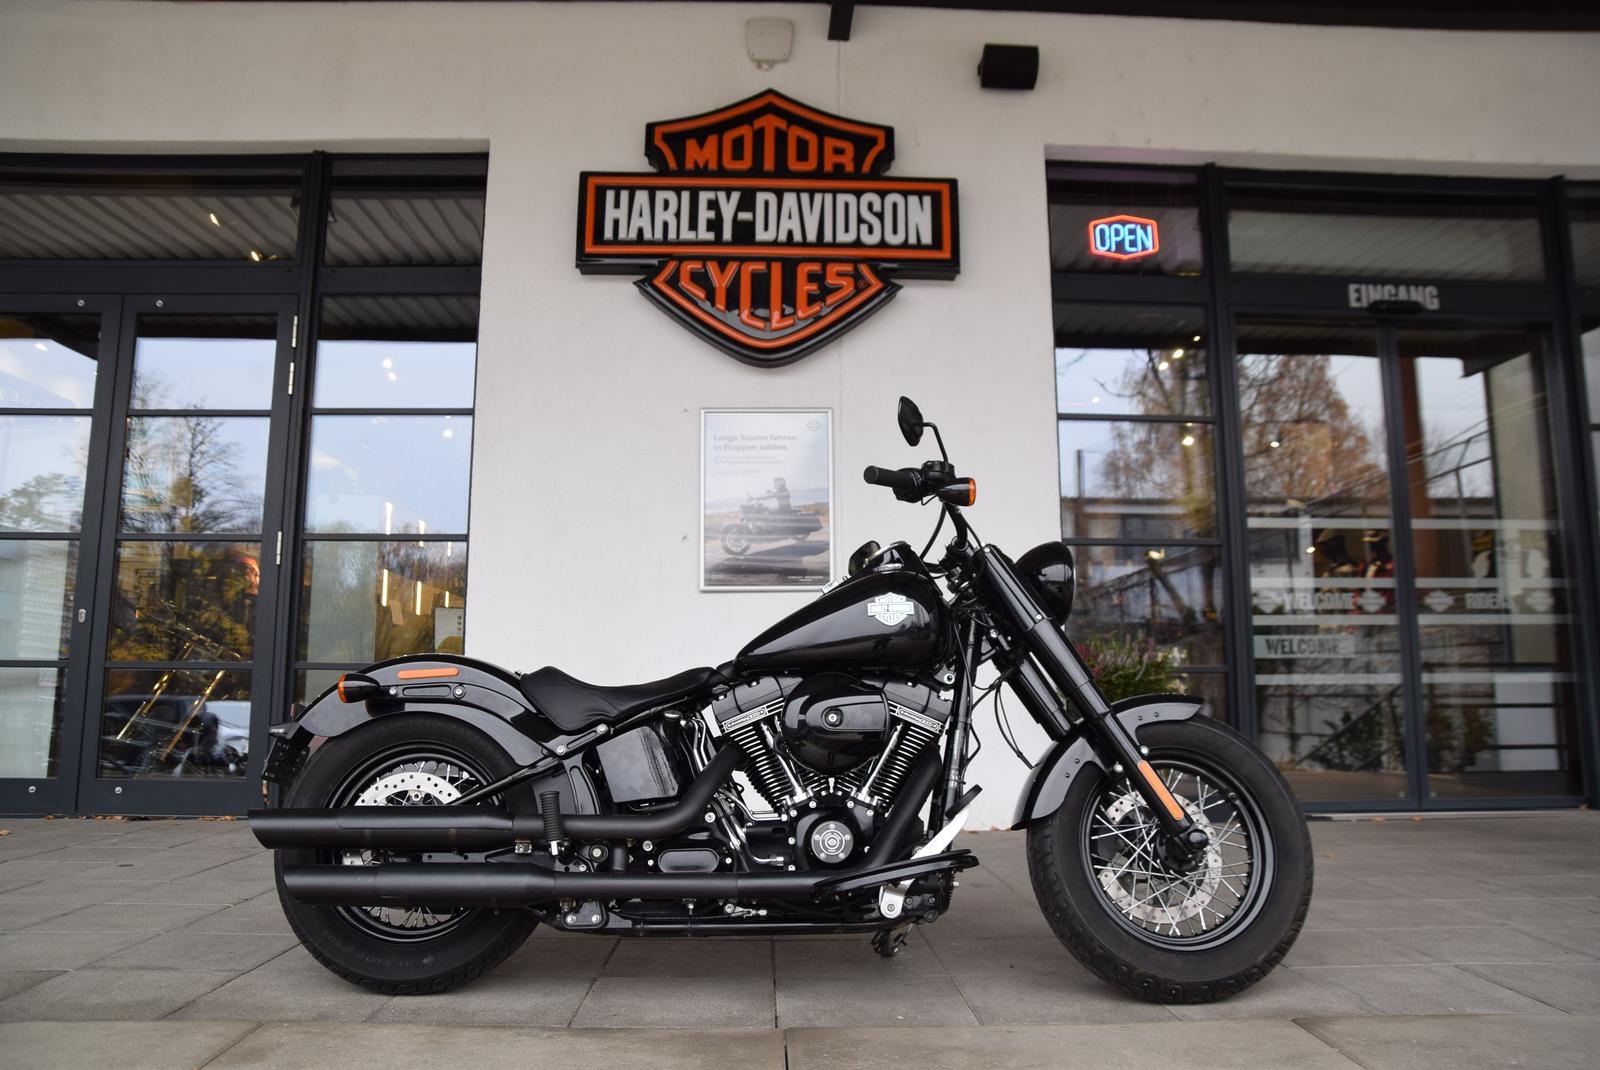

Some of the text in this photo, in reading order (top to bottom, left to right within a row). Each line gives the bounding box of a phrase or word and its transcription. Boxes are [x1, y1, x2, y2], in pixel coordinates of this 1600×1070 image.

[684, 112, 855, 174] MOTOR
[603, 188, 933, 246] HARLEY-DAVIDSON
[1094, 223, 1154, 253] OPEN
[679, 260, 856, 332] CYCLES
[1347, 283, 1441, 311] EINGANG
